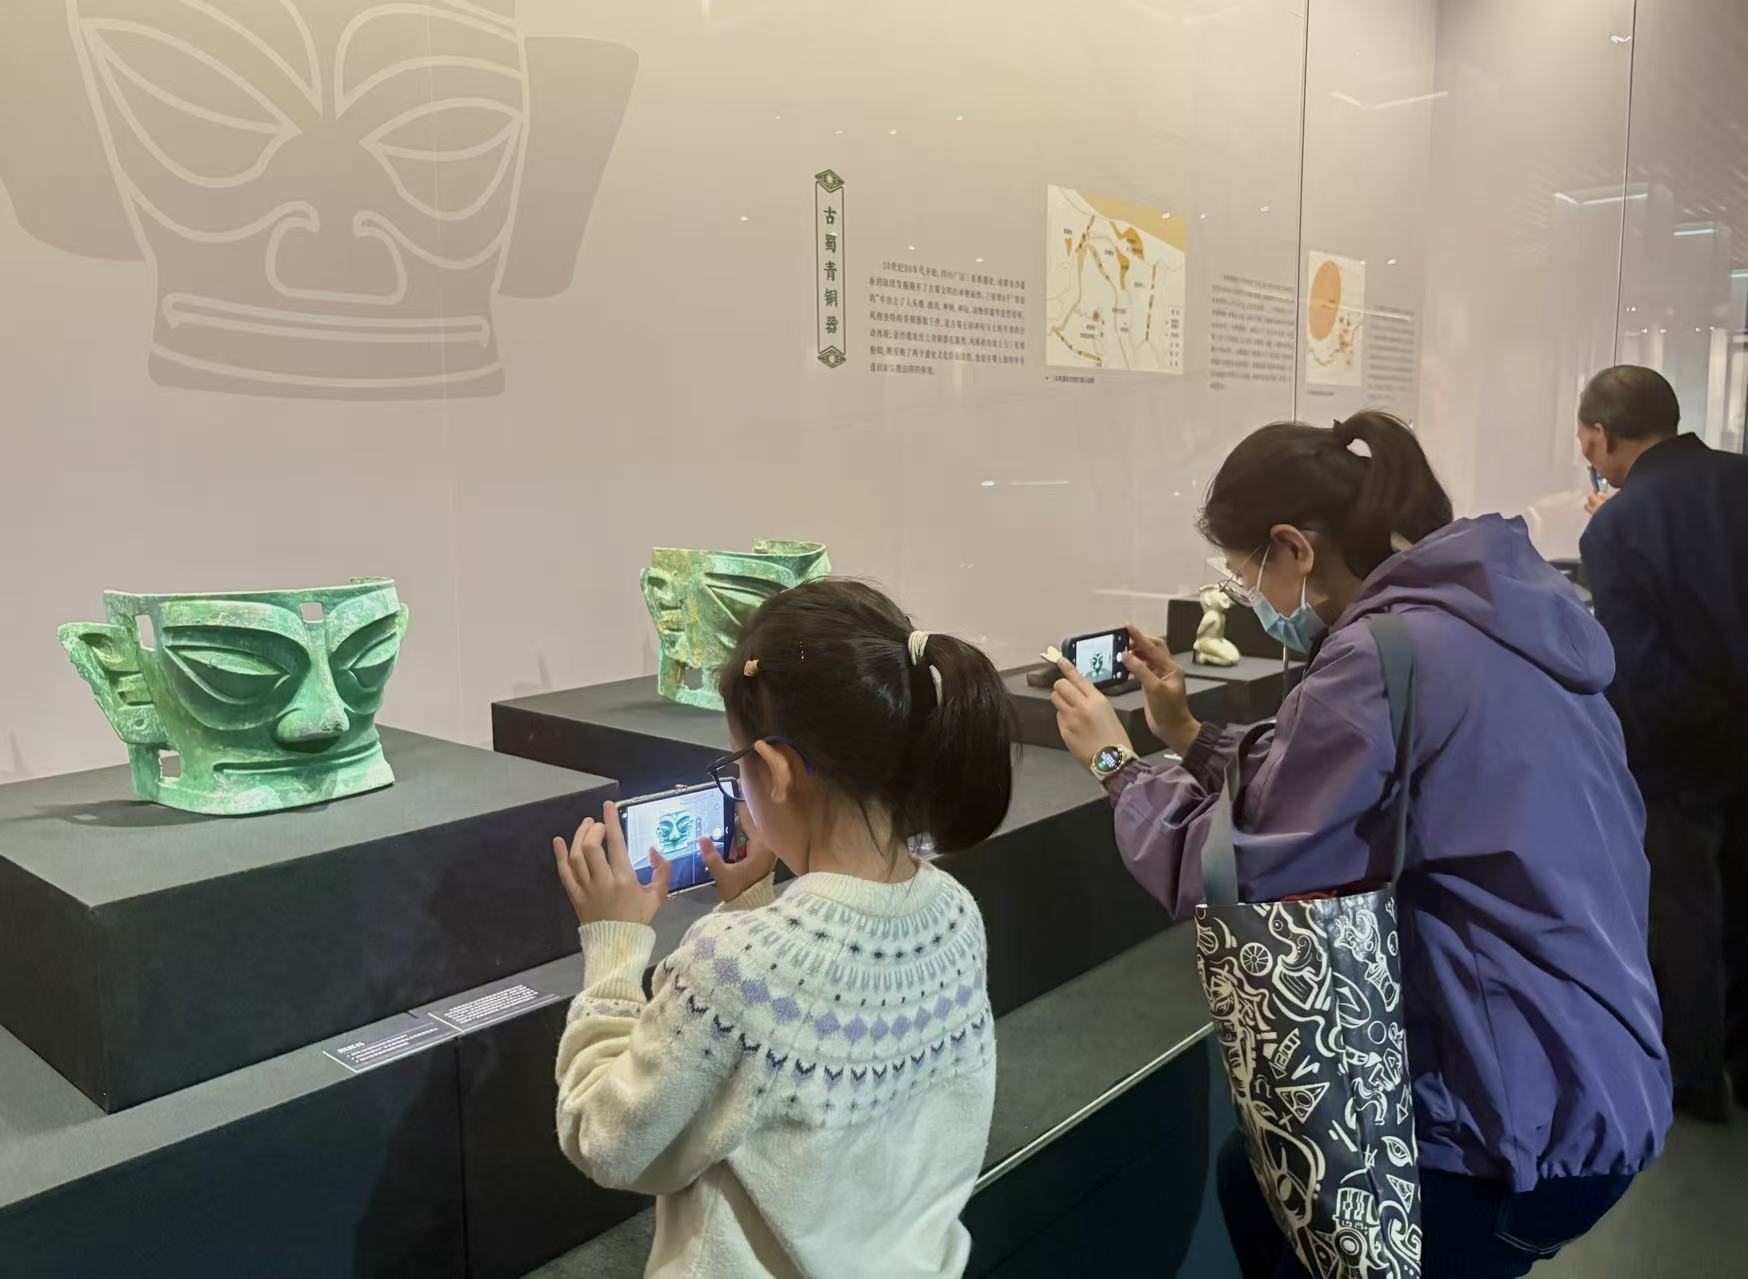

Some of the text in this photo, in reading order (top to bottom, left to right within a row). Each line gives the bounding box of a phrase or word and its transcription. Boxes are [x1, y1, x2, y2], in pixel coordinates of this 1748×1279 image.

[823, 205, 839, 334] 古蜀青铜器
